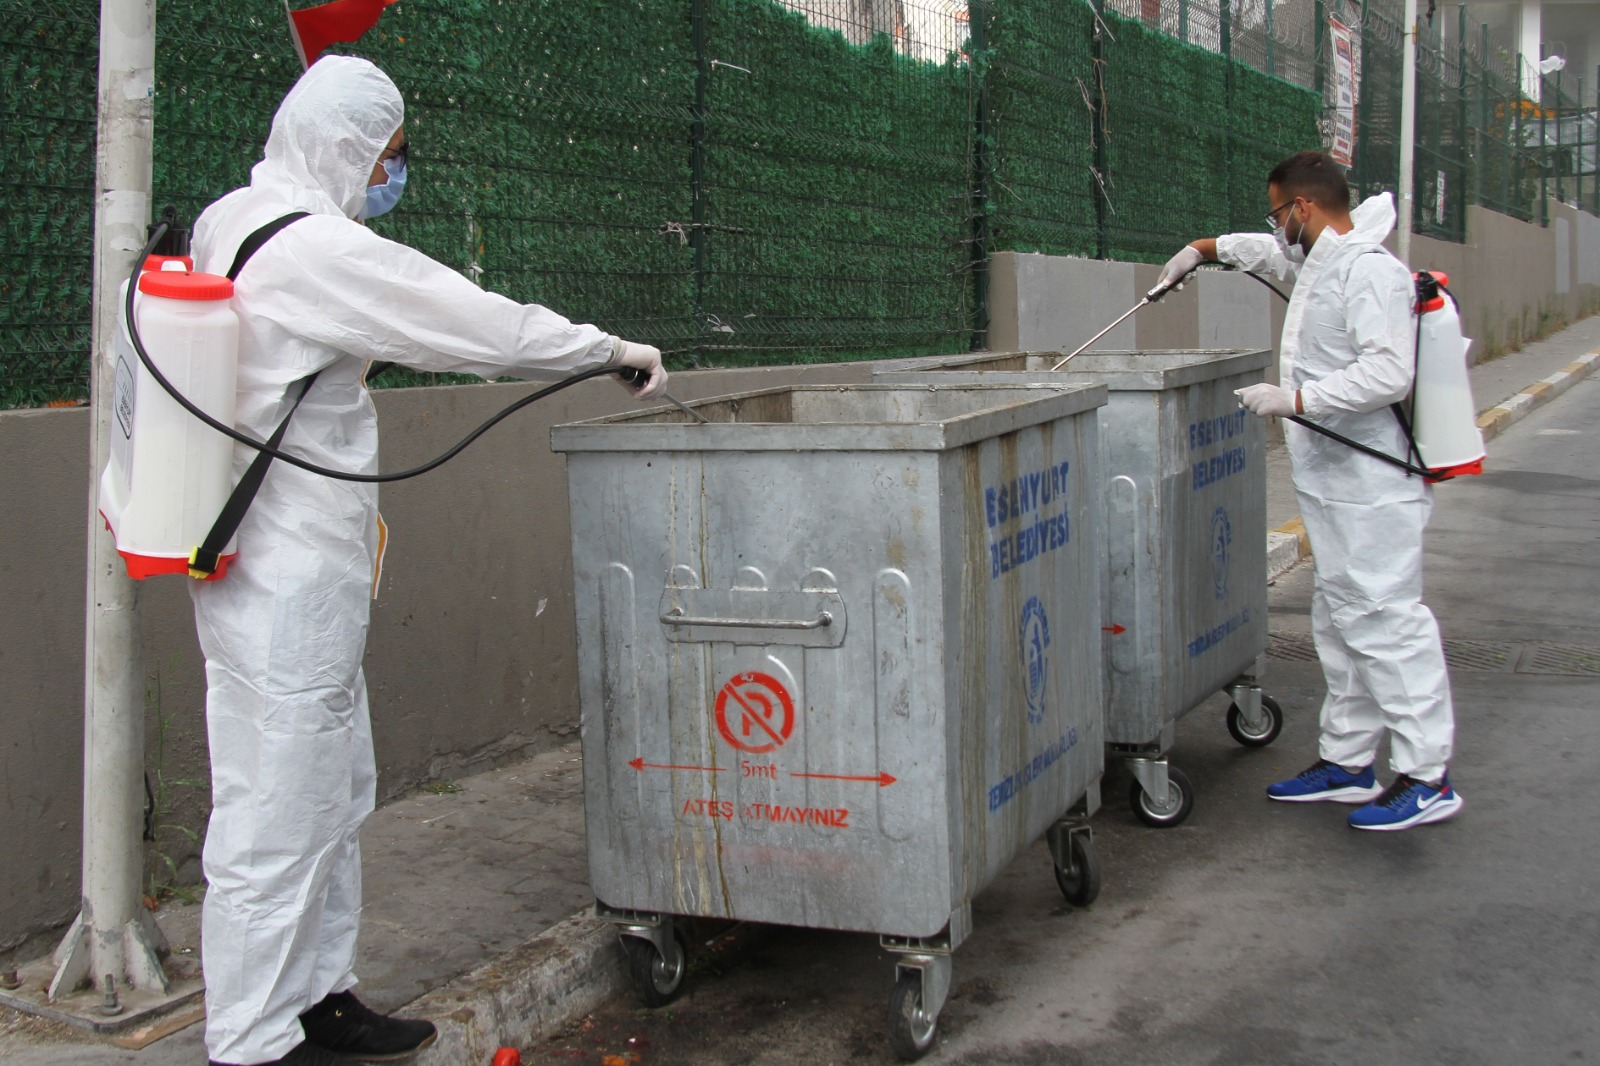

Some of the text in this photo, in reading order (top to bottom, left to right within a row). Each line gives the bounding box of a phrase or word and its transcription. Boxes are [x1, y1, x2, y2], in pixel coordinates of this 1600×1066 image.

[1189, 409, 1246, 450] ESENYURT
[985, 461, 1069, 528] ESENYURT
[740, 760, 777, 780] 5mt
